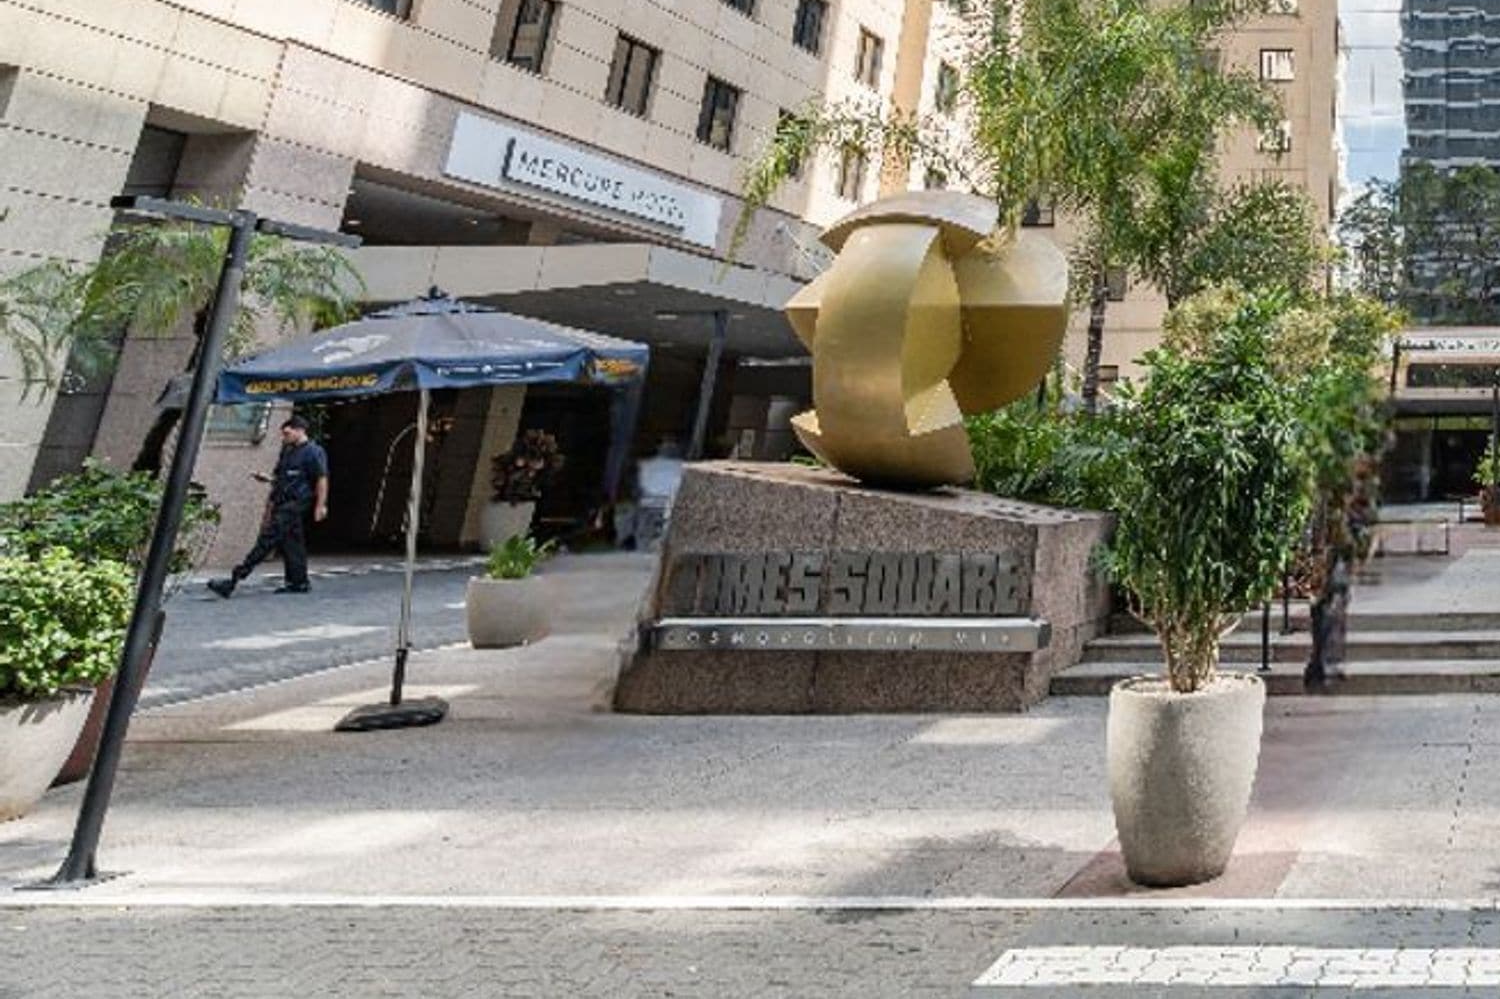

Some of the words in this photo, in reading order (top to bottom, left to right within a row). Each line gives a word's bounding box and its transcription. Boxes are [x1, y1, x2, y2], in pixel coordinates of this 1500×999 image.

[518, 150, 625, 201] MERCURE
[661, 552, 823, 614] TIMES
[827, 551, 1026, 614] SQUARE
